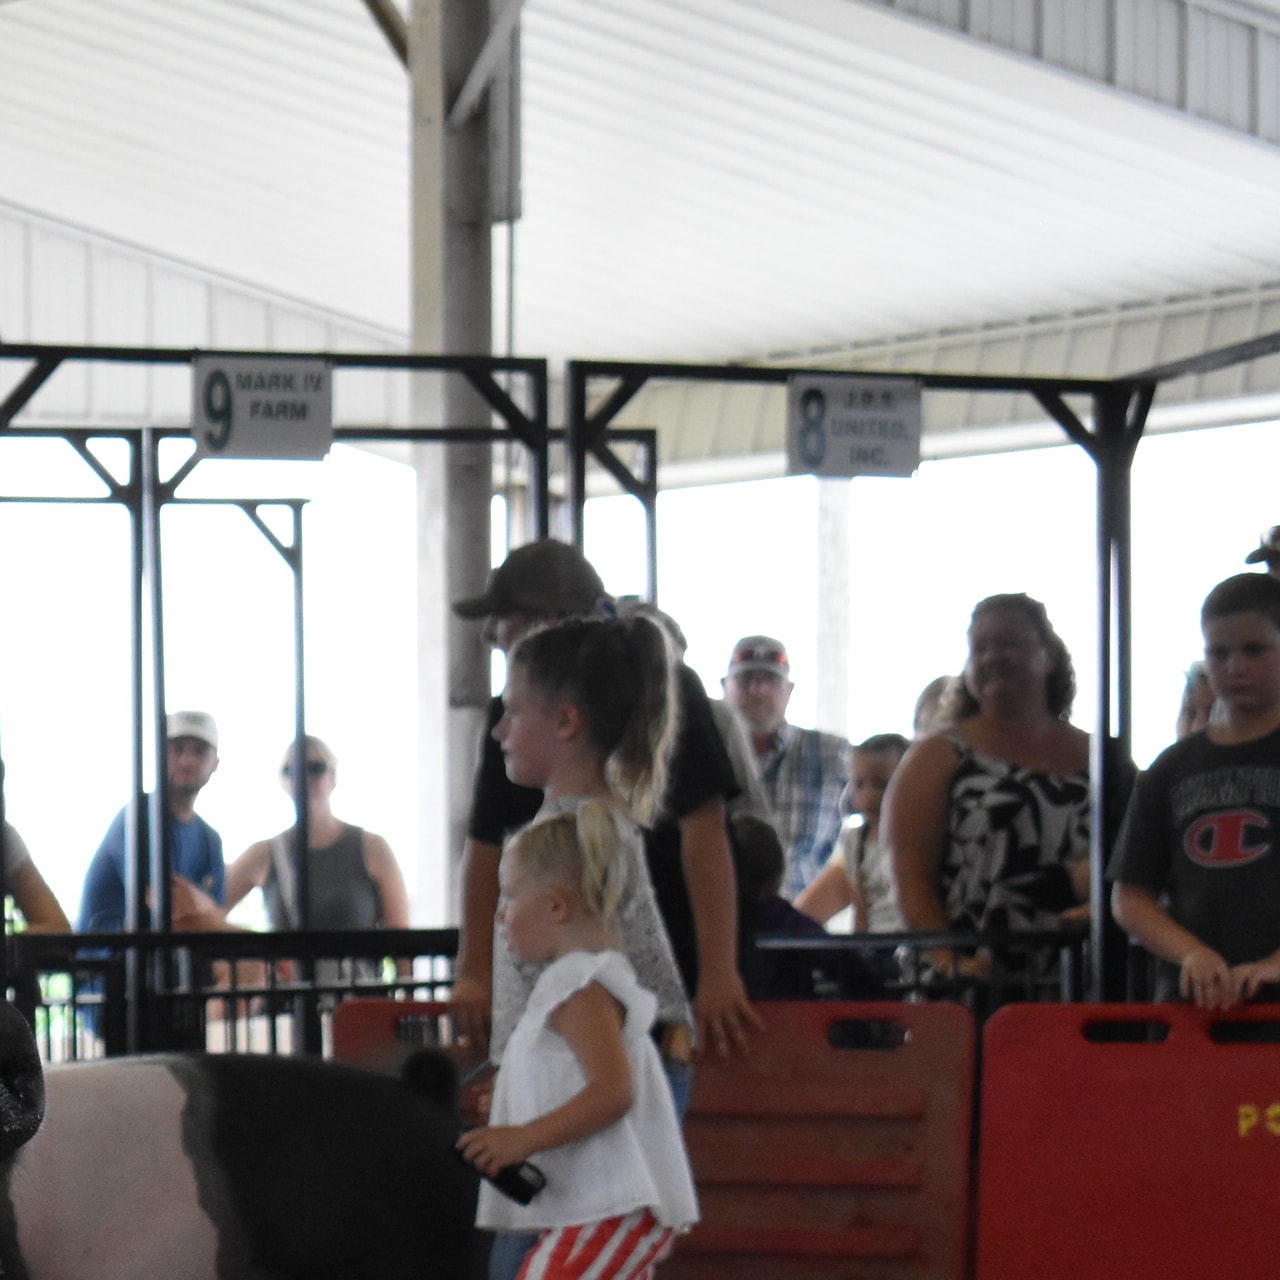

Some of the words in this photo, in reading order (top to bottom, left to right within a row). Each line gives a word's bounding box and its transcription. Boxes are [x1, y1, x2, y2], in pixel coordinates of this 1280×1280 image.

[203, 368, 233, 451] 9
[236, 373, 295, 392] MARK
[304, 373, 324, 393] IV
[250, 400, 308, 420] FARM
[799, 387, 826, 467] 8
